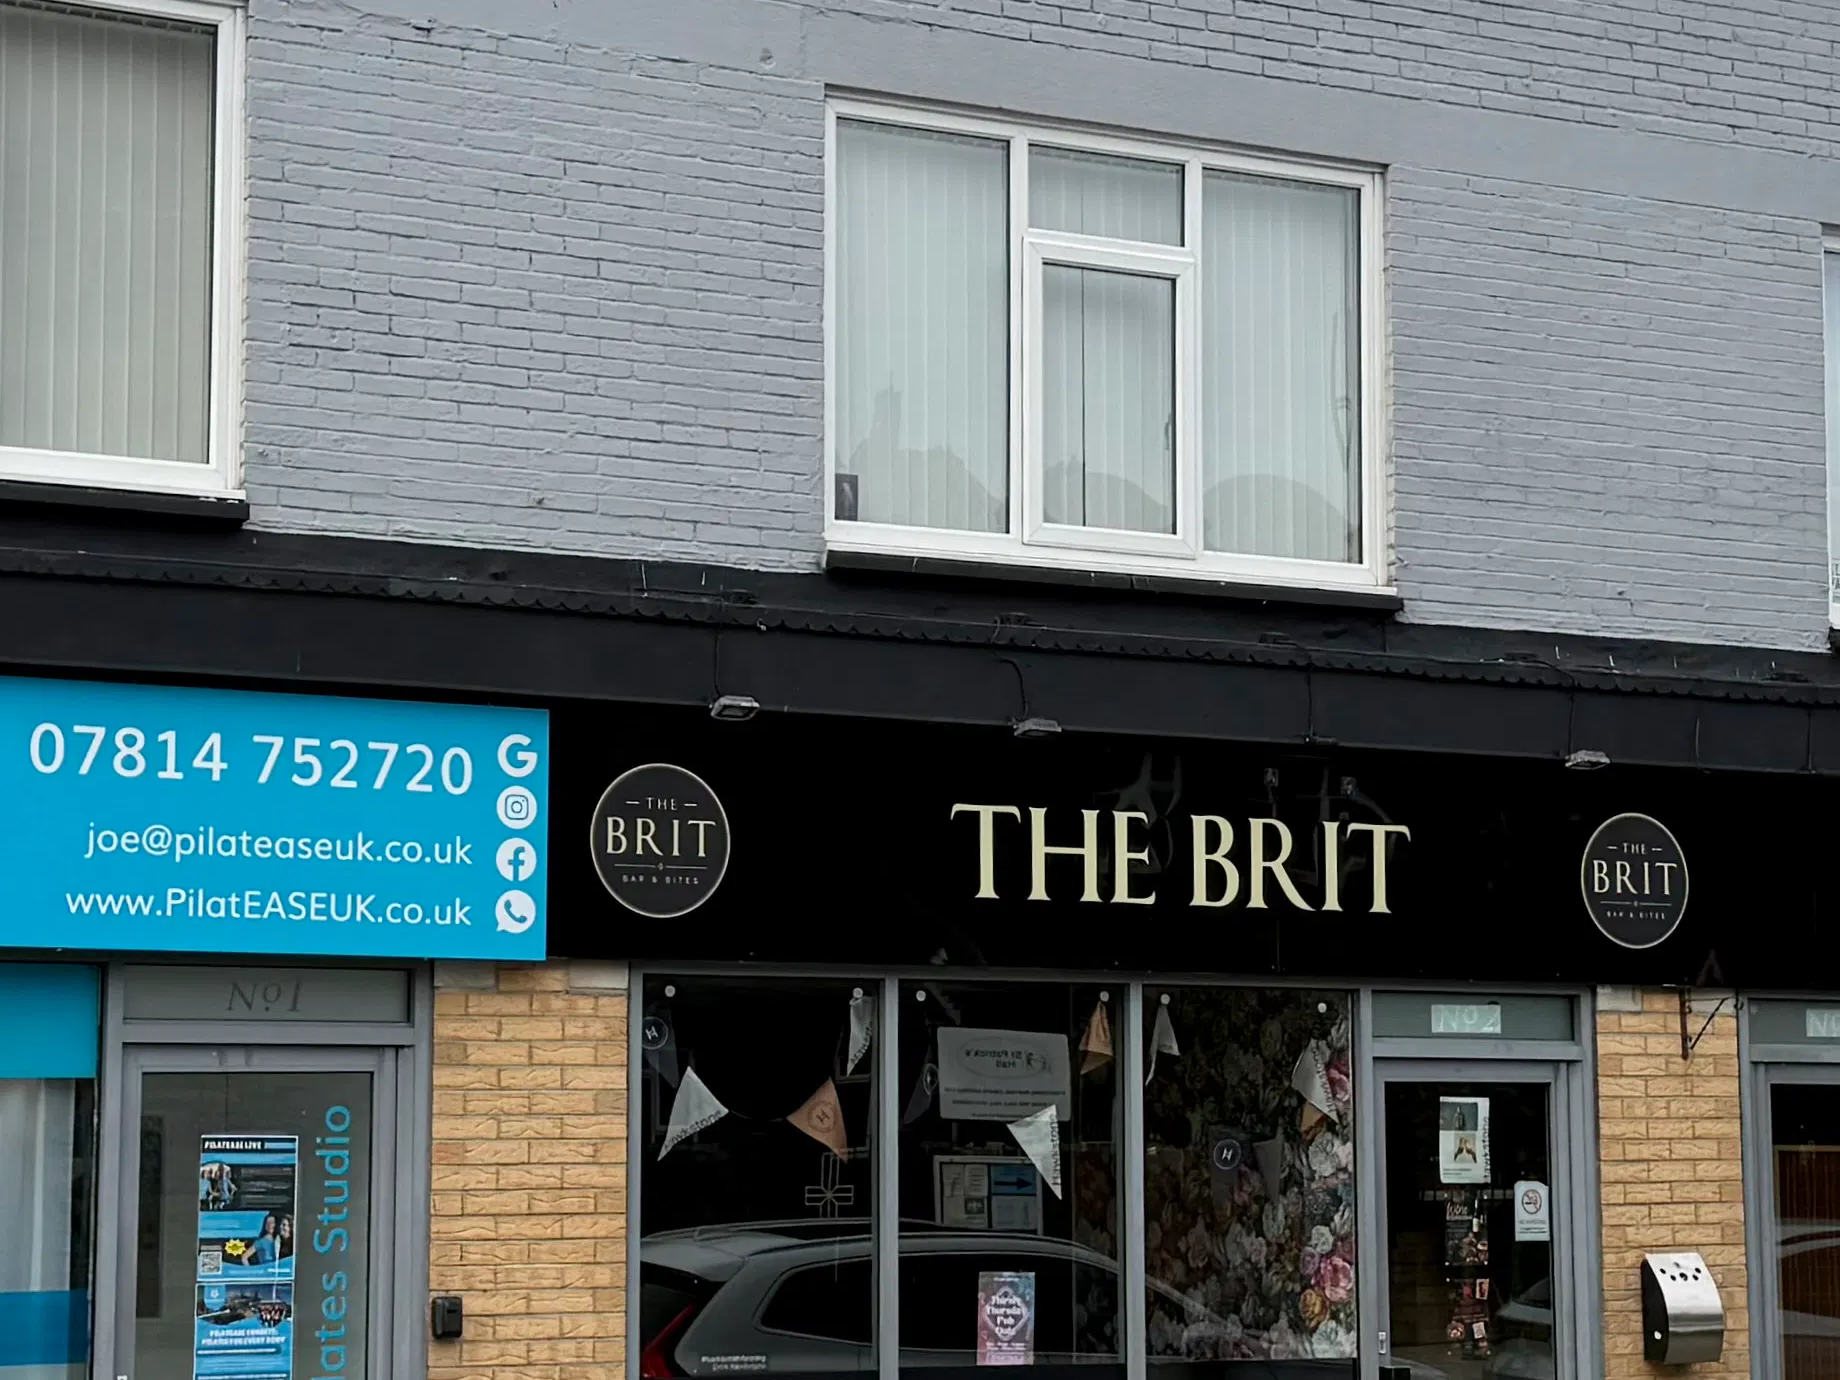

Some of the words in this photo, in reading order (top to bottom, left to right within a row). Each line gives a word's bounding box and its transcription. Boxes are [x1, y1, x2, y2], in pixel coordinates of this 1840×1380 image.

[29, 722, 229, 782] 07814
[252, 733, 474, 795] 752720
[645, 796, 678, 811] THE
[83, 821, 473, 866] joe@pilateaseuk.co.uk
[605, 815, 716, 858] BRIT
[1622, 842, 1648, 855] THE
[950, 803, 1157, 905] THE
[1189, 813, 1411, 914] BRIT
[1592, 858, 1678, 896] BRIT
[622, 874, 645, 884] BAR
[665, 875, 699, 885] BITES
[65, 887, 473, 926] www.PilatEASEUK.co.uk
[313, 1104, 351, 1254] Studio
